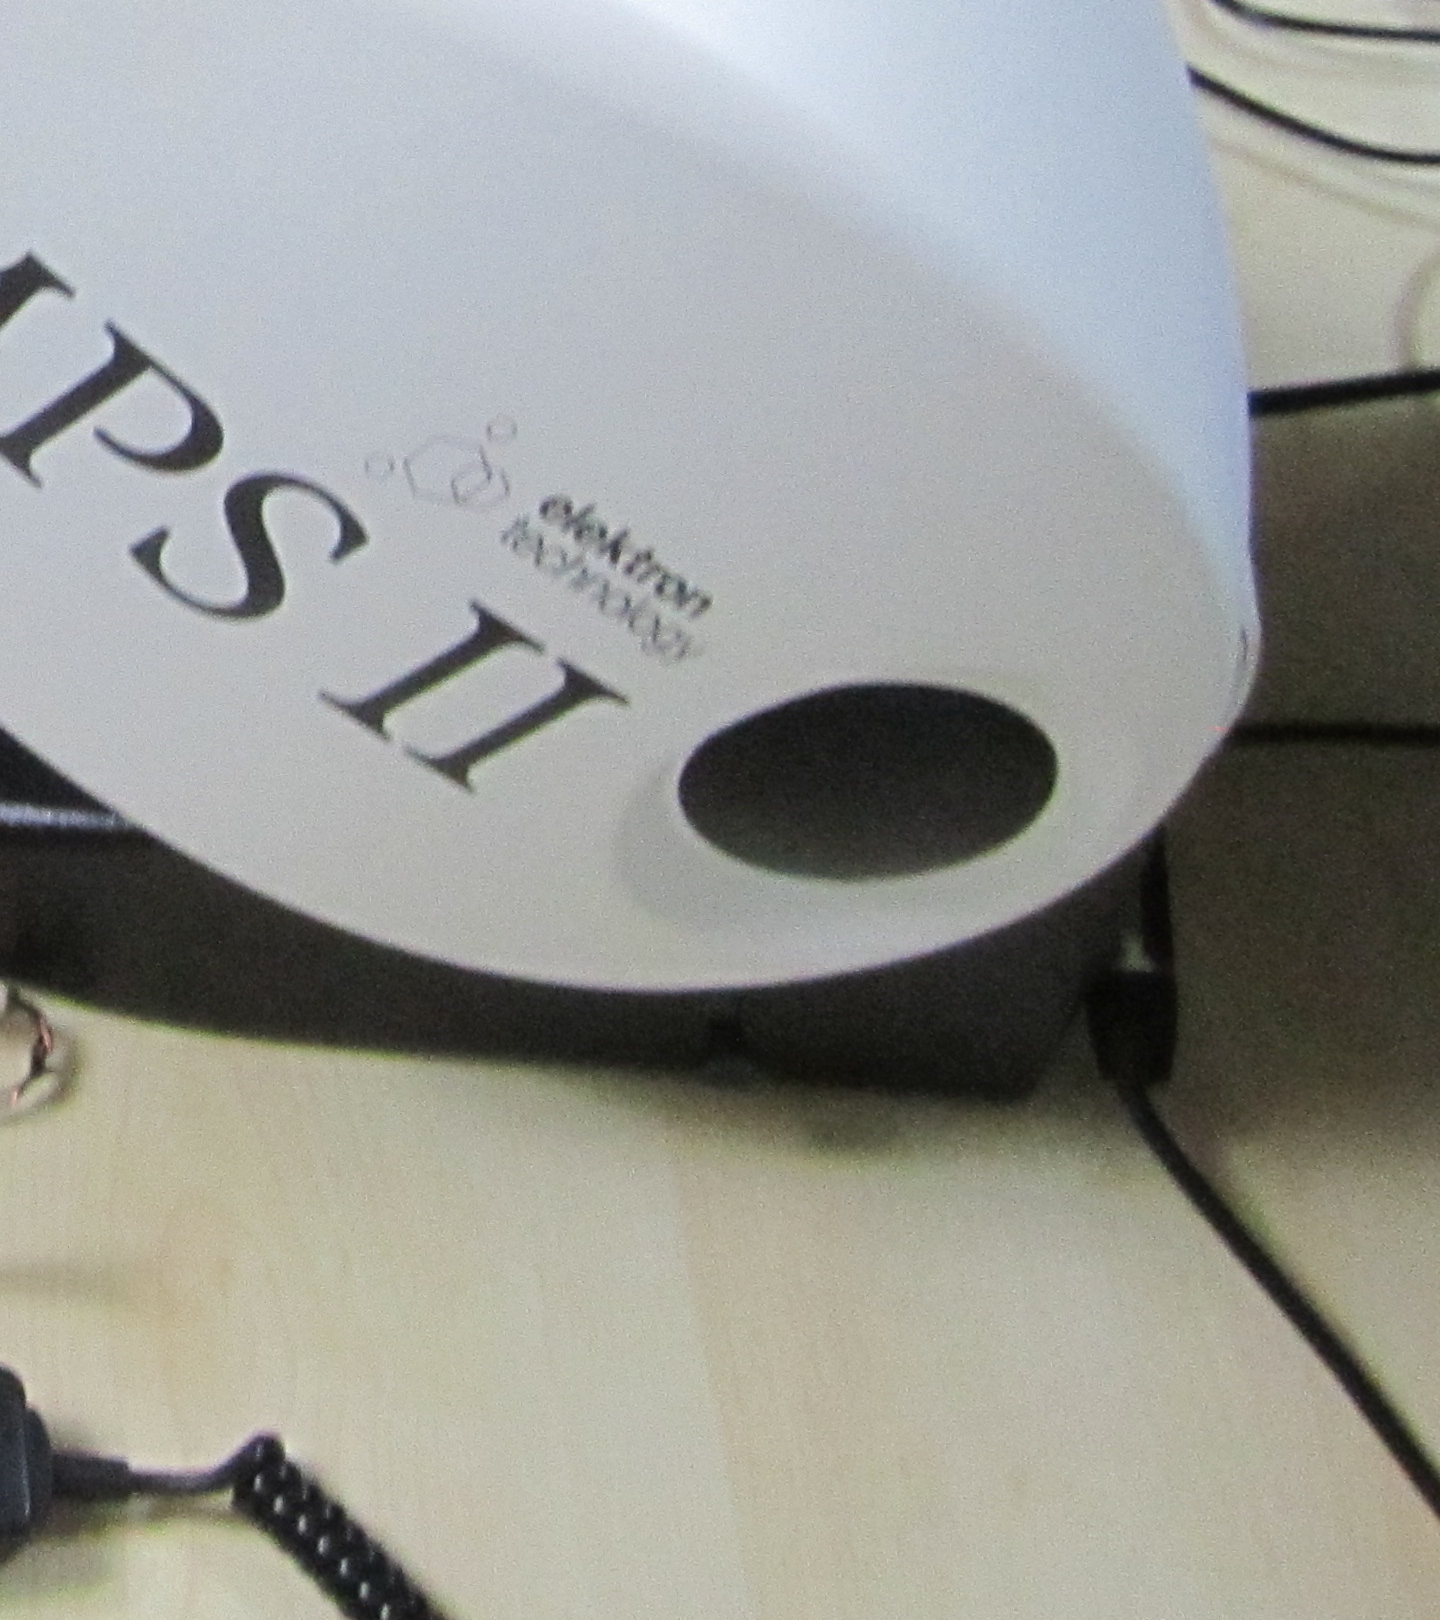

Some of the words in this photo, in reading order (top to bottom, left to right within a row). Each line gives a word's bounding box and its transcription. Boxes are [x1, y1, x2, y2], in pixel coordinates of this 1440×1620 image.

[500, 512, 704, 661] technology
[538, 493, 713, 619] elektron
[320, 599, 631, 793] II
